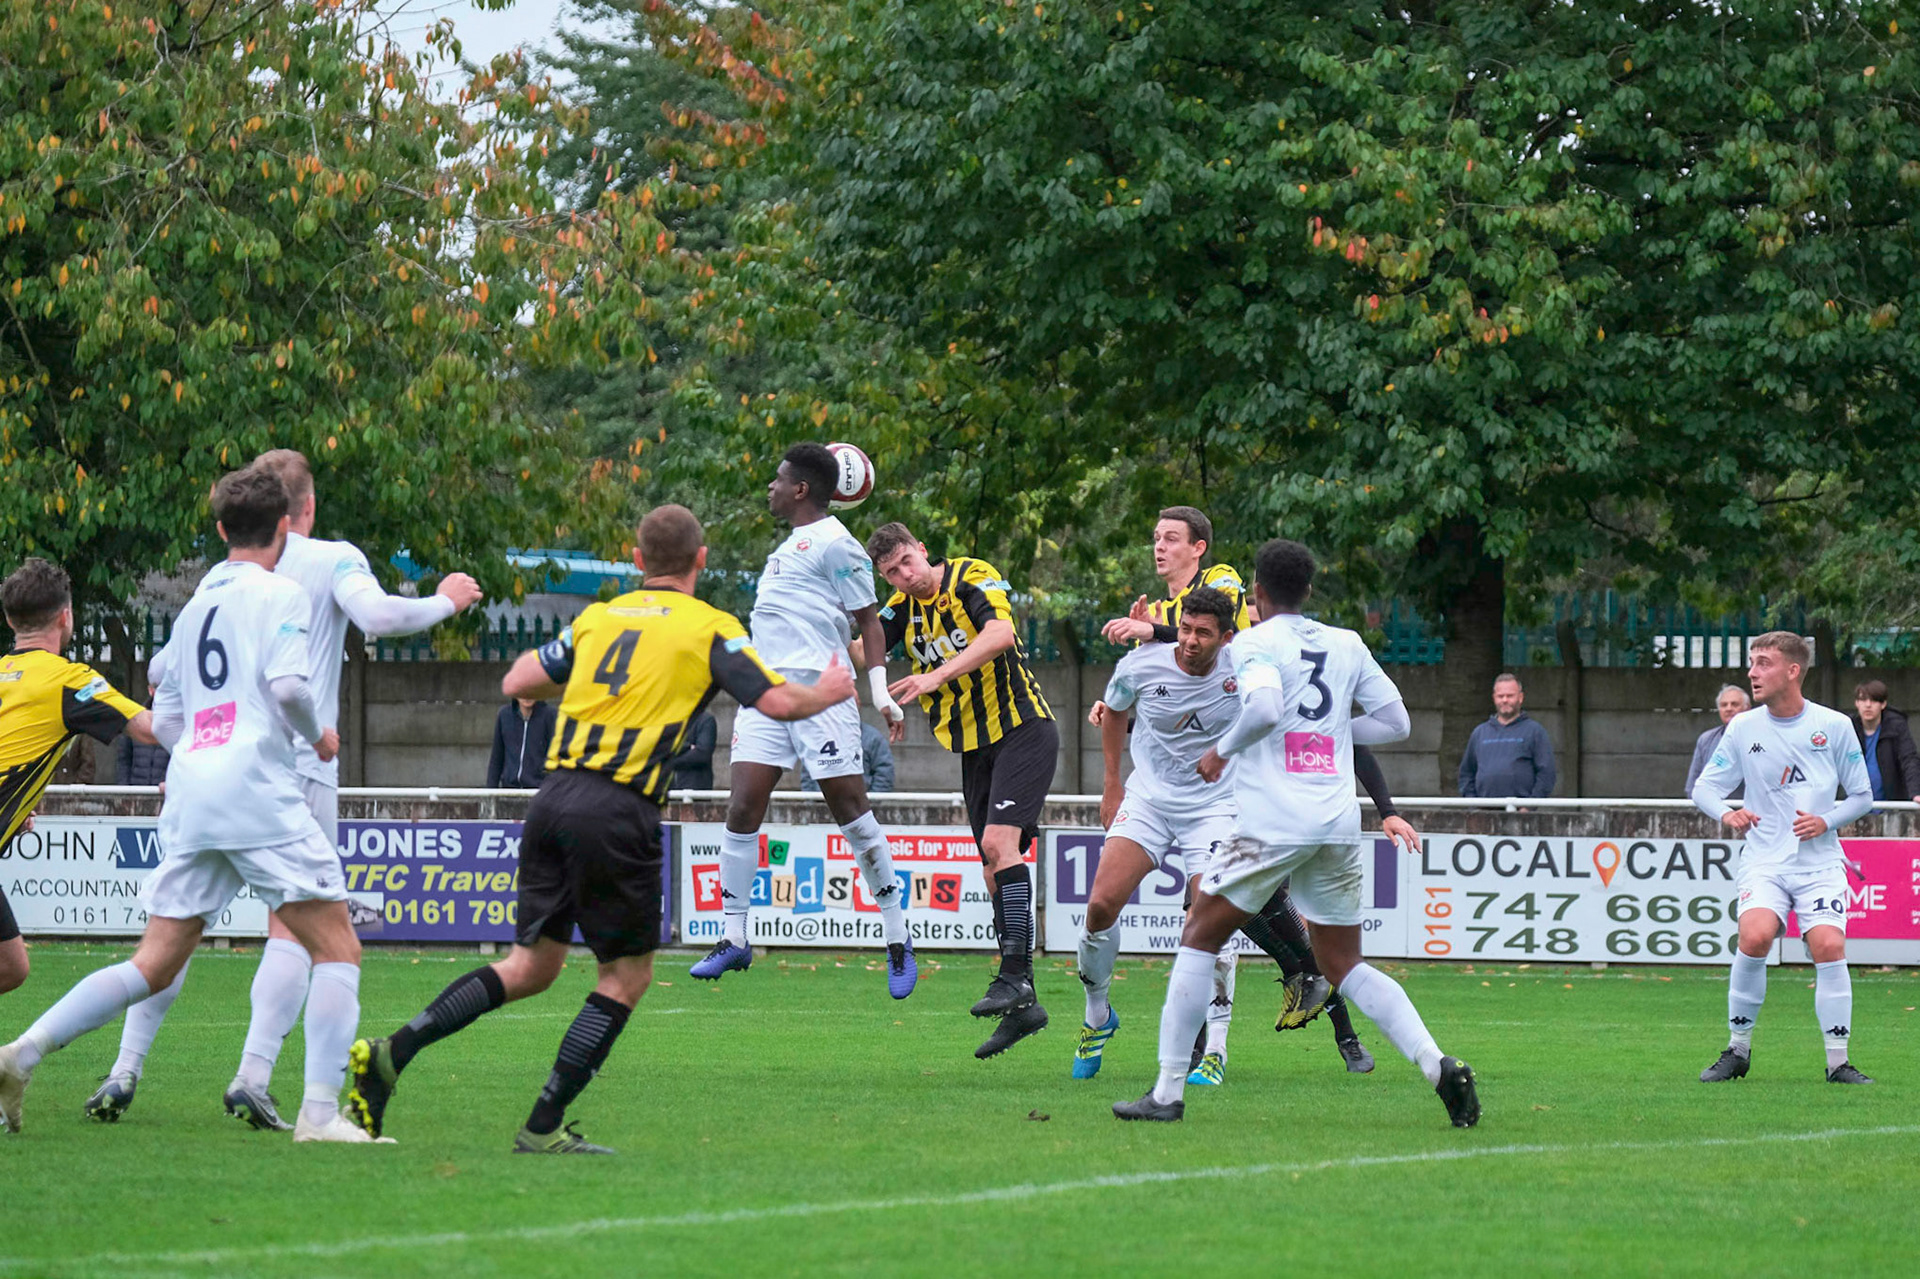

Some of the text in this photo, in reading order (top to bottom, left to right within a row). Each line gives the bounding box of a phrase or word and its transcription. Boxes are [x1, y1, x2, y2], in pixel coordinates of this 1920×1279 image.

[197, 605, 228, 690] 6
[593, 629, 643, 696] 4
[1297, 649, 1333, 721] 3
[820, 740, 839, 756] 4
[108, 838, 126, 863] A
[338, 828, 523, 859] JONES Ex
[832, 838, 854, 856] Liv
[918, 839, 942, 857] for
[1421, 838, 1744, 881] LOCAL CAR
[10, 879, 139, 898] ACCOUNTAN
[345, 864, 410, 892] TFC
[54, 906, 148, 925] 0161 74
[385, 899, 456, 924] 0161
[1466, 891, 1580, 921] 747
[1813, 897, 1844, 914] 10
[1141, 915, 1185, 928] TRAFF
[1424, 887, 1453, 955] 0161
[1465, 926, 1580, 954] 748
